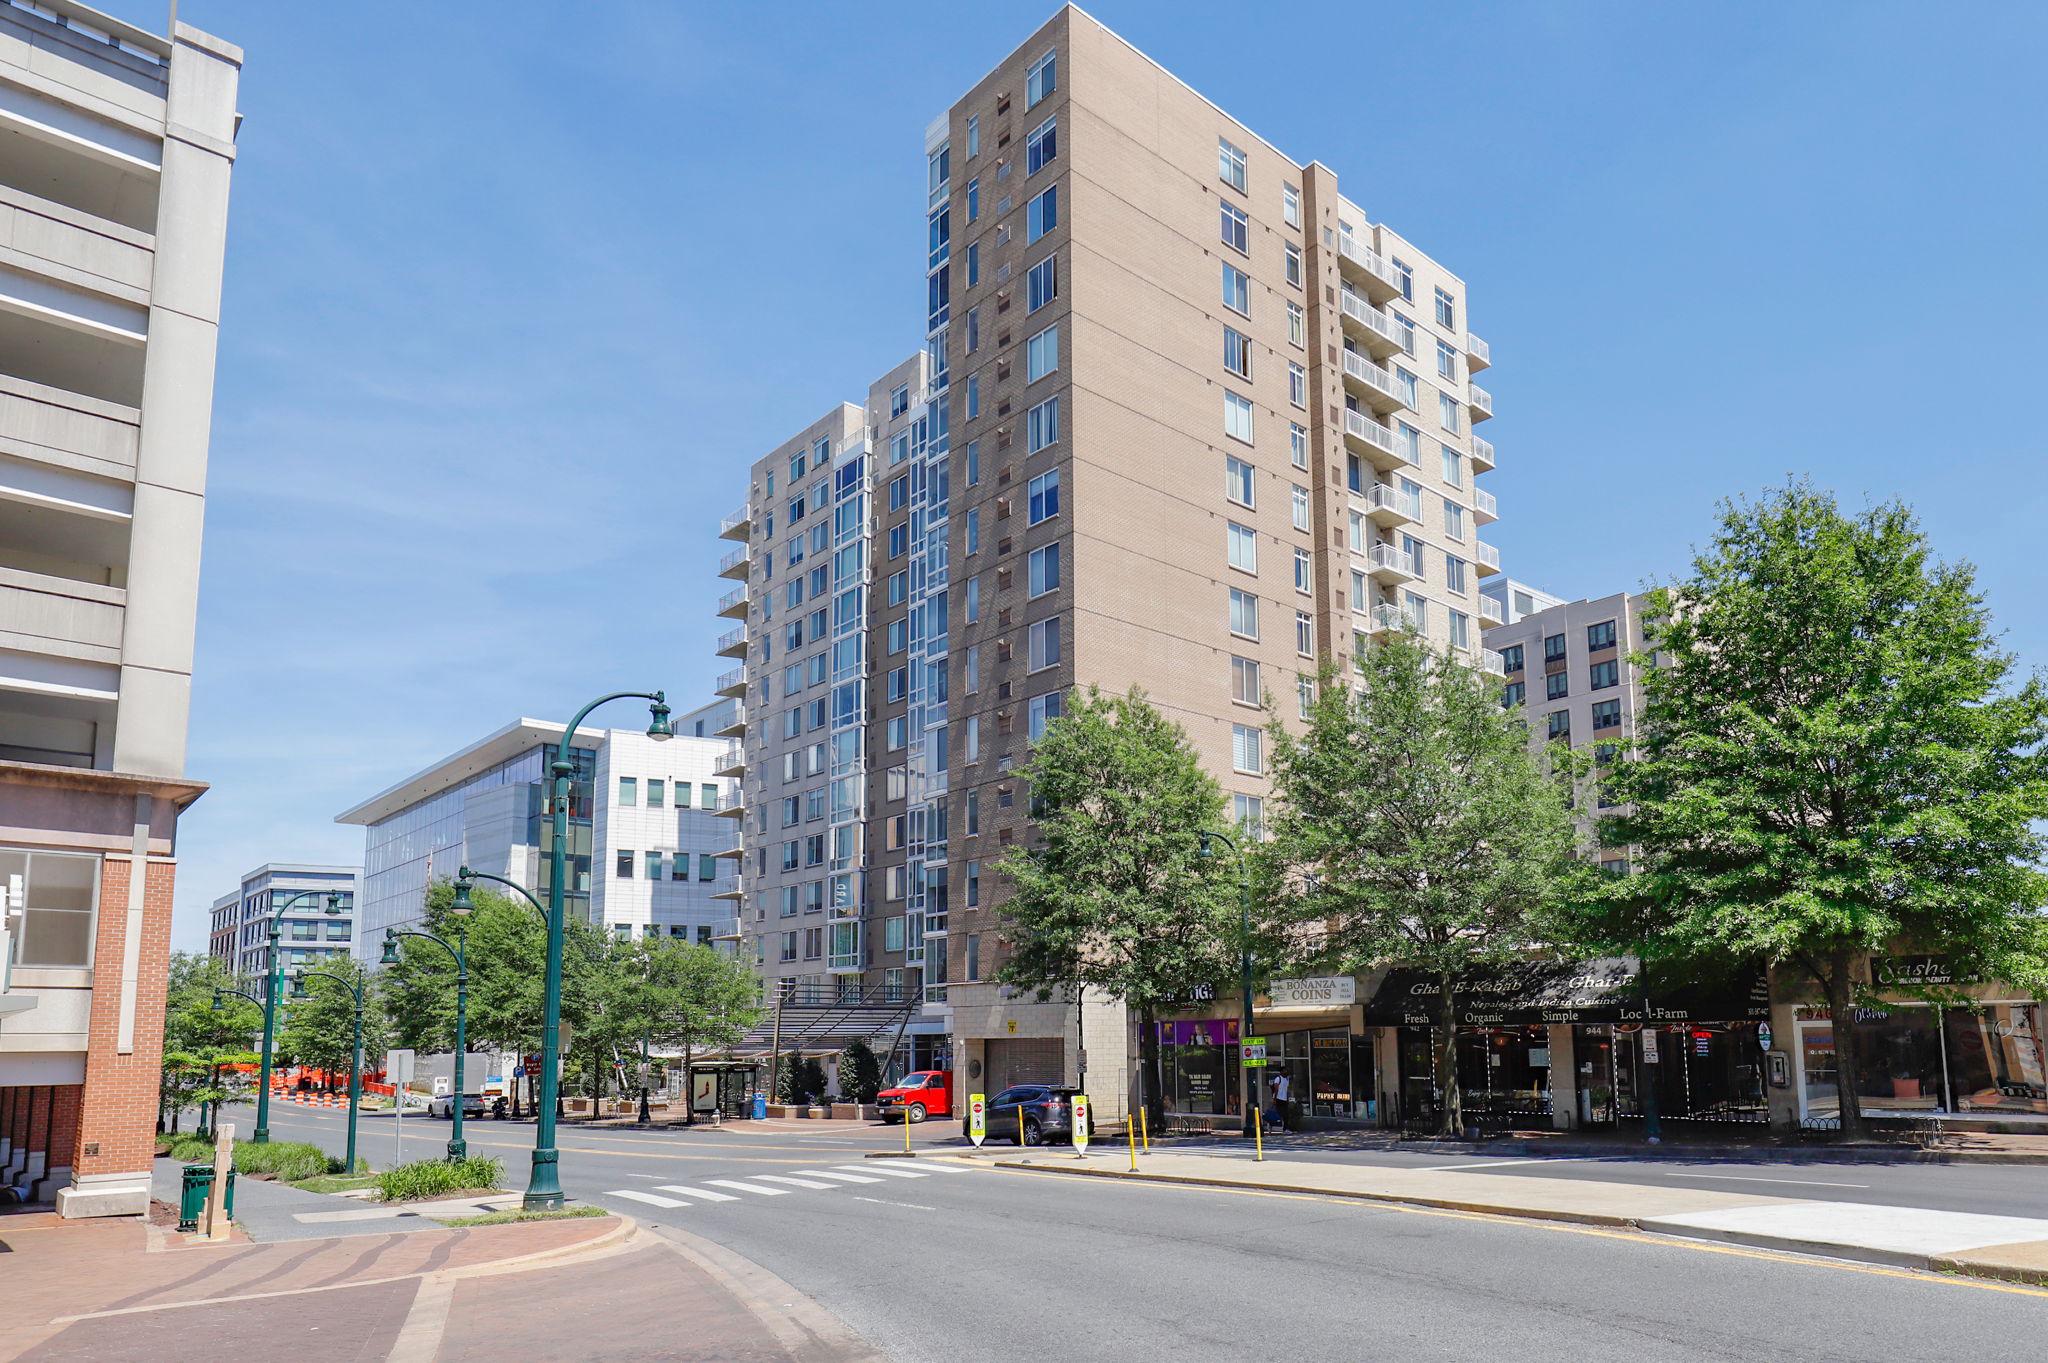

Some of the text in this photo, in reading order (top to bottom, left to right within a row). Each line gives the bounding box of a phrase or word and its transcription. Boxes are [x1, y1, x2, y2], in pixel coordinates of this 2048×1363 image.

[1286, 979, 1336, 990] BONANZA
[1291, 989, 1332, 1001] COINS
[1516, 999, 1535, 1008] and
[1575, 997, 1617, 1007] Cuisine
[1404, 1007, 1688, 1025] Fresh Organic Simple Locl-Farm
[1586, 1027, 1602, 1035] 944
